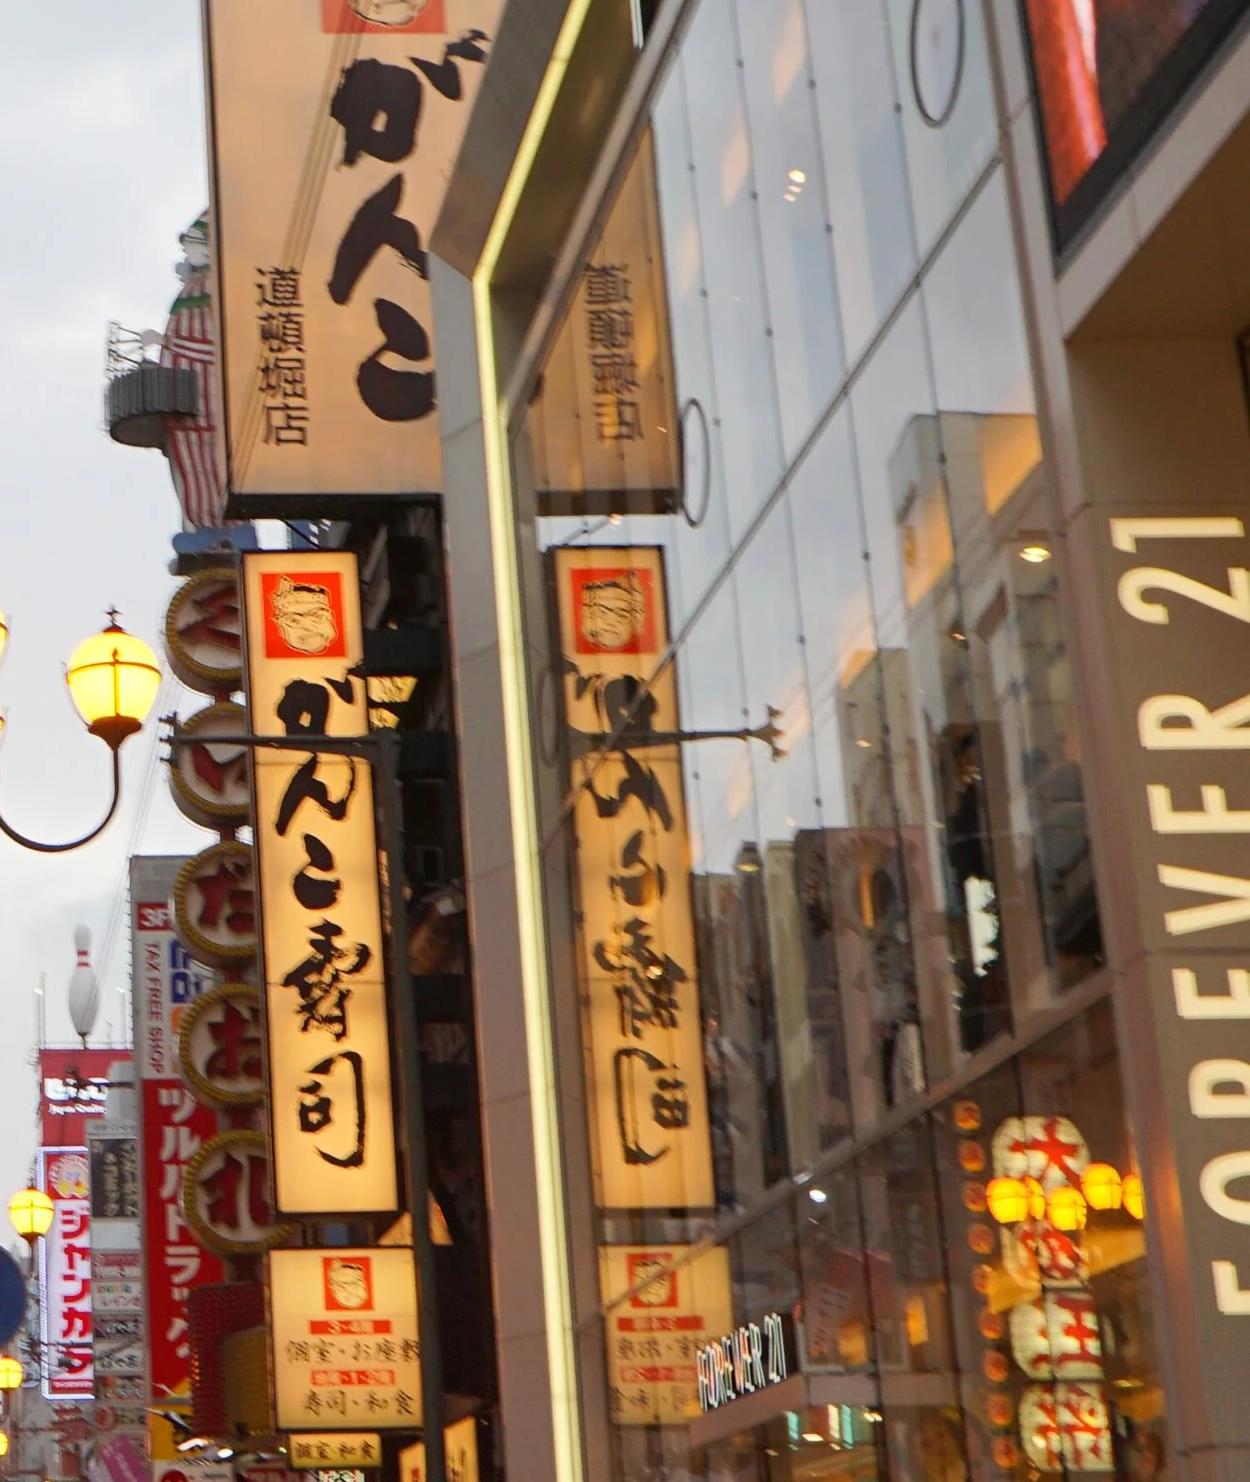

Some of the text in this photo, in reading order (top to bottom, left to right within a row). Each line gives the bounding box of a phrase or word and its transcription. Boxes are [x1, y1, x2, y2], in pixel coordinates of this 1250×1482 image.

[327, 28, 491, 423] がんこ
[254, 264, 309, 447] 道頓堀店
[1110, 518, 1250, 625] 21
[146, 942, 164, 1074] TAX FREE SHOP
[1138, 693, 1250, 1317] EVER
[60, 1206, 92, 1376] ジャンカラ
[697, 1322, 766, 1413] FOREVER
[764, 1312, 788, 1384] 21
